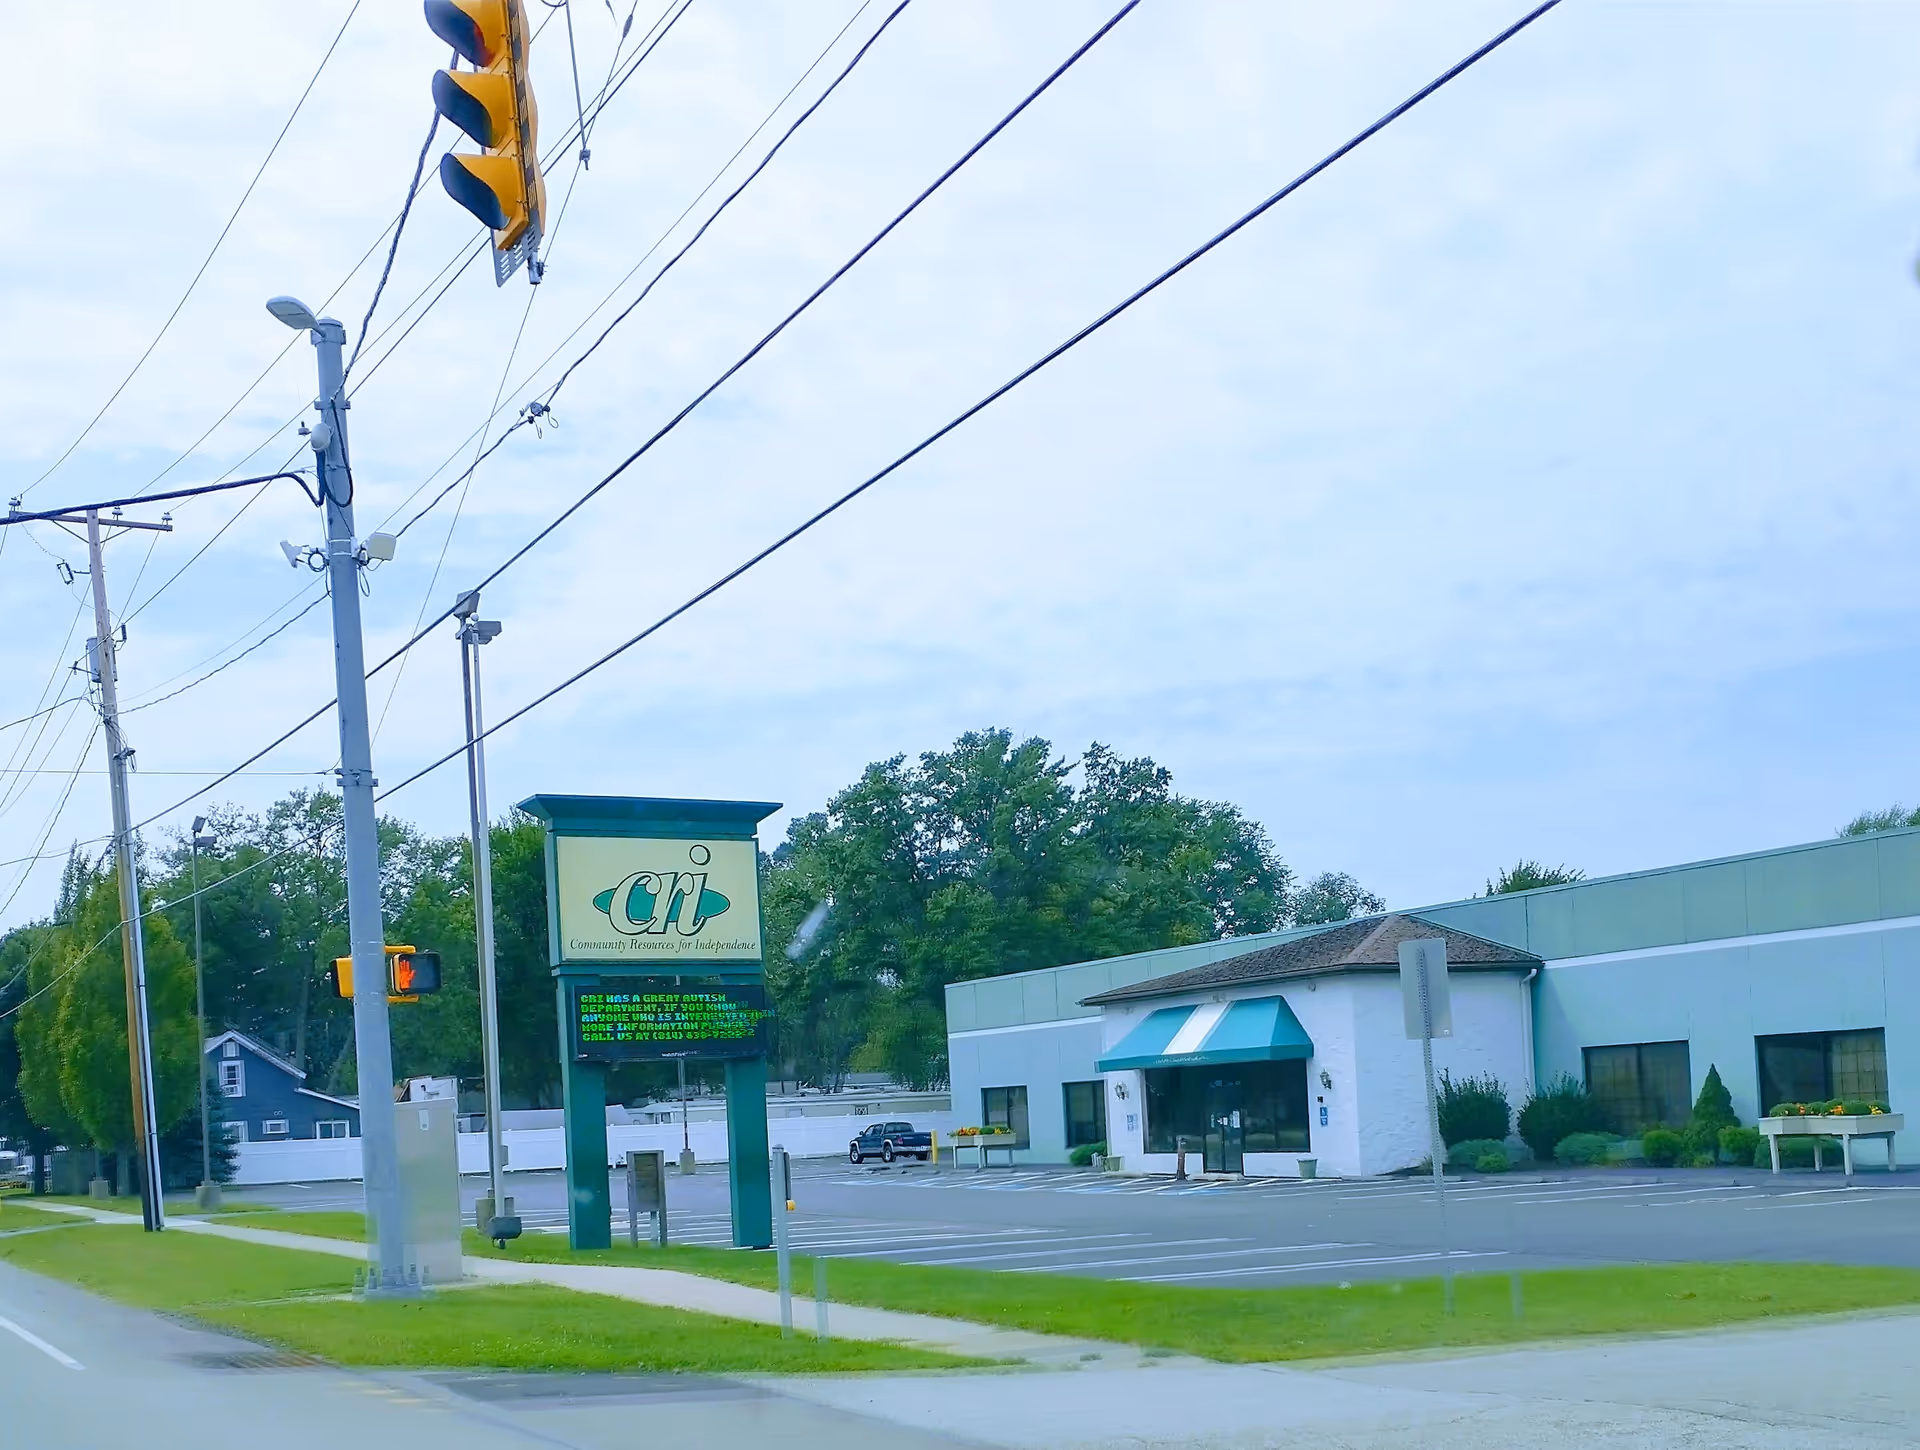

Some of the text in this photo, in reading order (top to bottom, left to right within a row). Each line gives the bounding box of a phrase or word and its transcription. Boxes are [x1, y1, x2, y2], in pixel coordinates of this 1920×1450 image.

[570, 938, 756, 954] Community Resources for Independence
[580, 993, 726, 1003] CRI HAS A GREAT AUTISM
[664, 1003, 678, 1012] IF
[681, 1003, 704, 1011] YOU
[706, 1003, 738, 1011] KNOW
[581, 1013, 630, 1022] ANYONE
[632, 1013, 655, 1021] WHO
[657, 1013, 672, 1021] IS
[674, 1012, 747, 1021] INTERESTED
[581, 1023, 614, 1031] MORE
[616, 1022, 698, 1031] INFORMATION
[582, 1033, 615, 1041] CALL
[617, 1033, 633, 1041] US
[635, 1033, 650, 1041] AT
[652, 1032, 684, 1040] (814)
